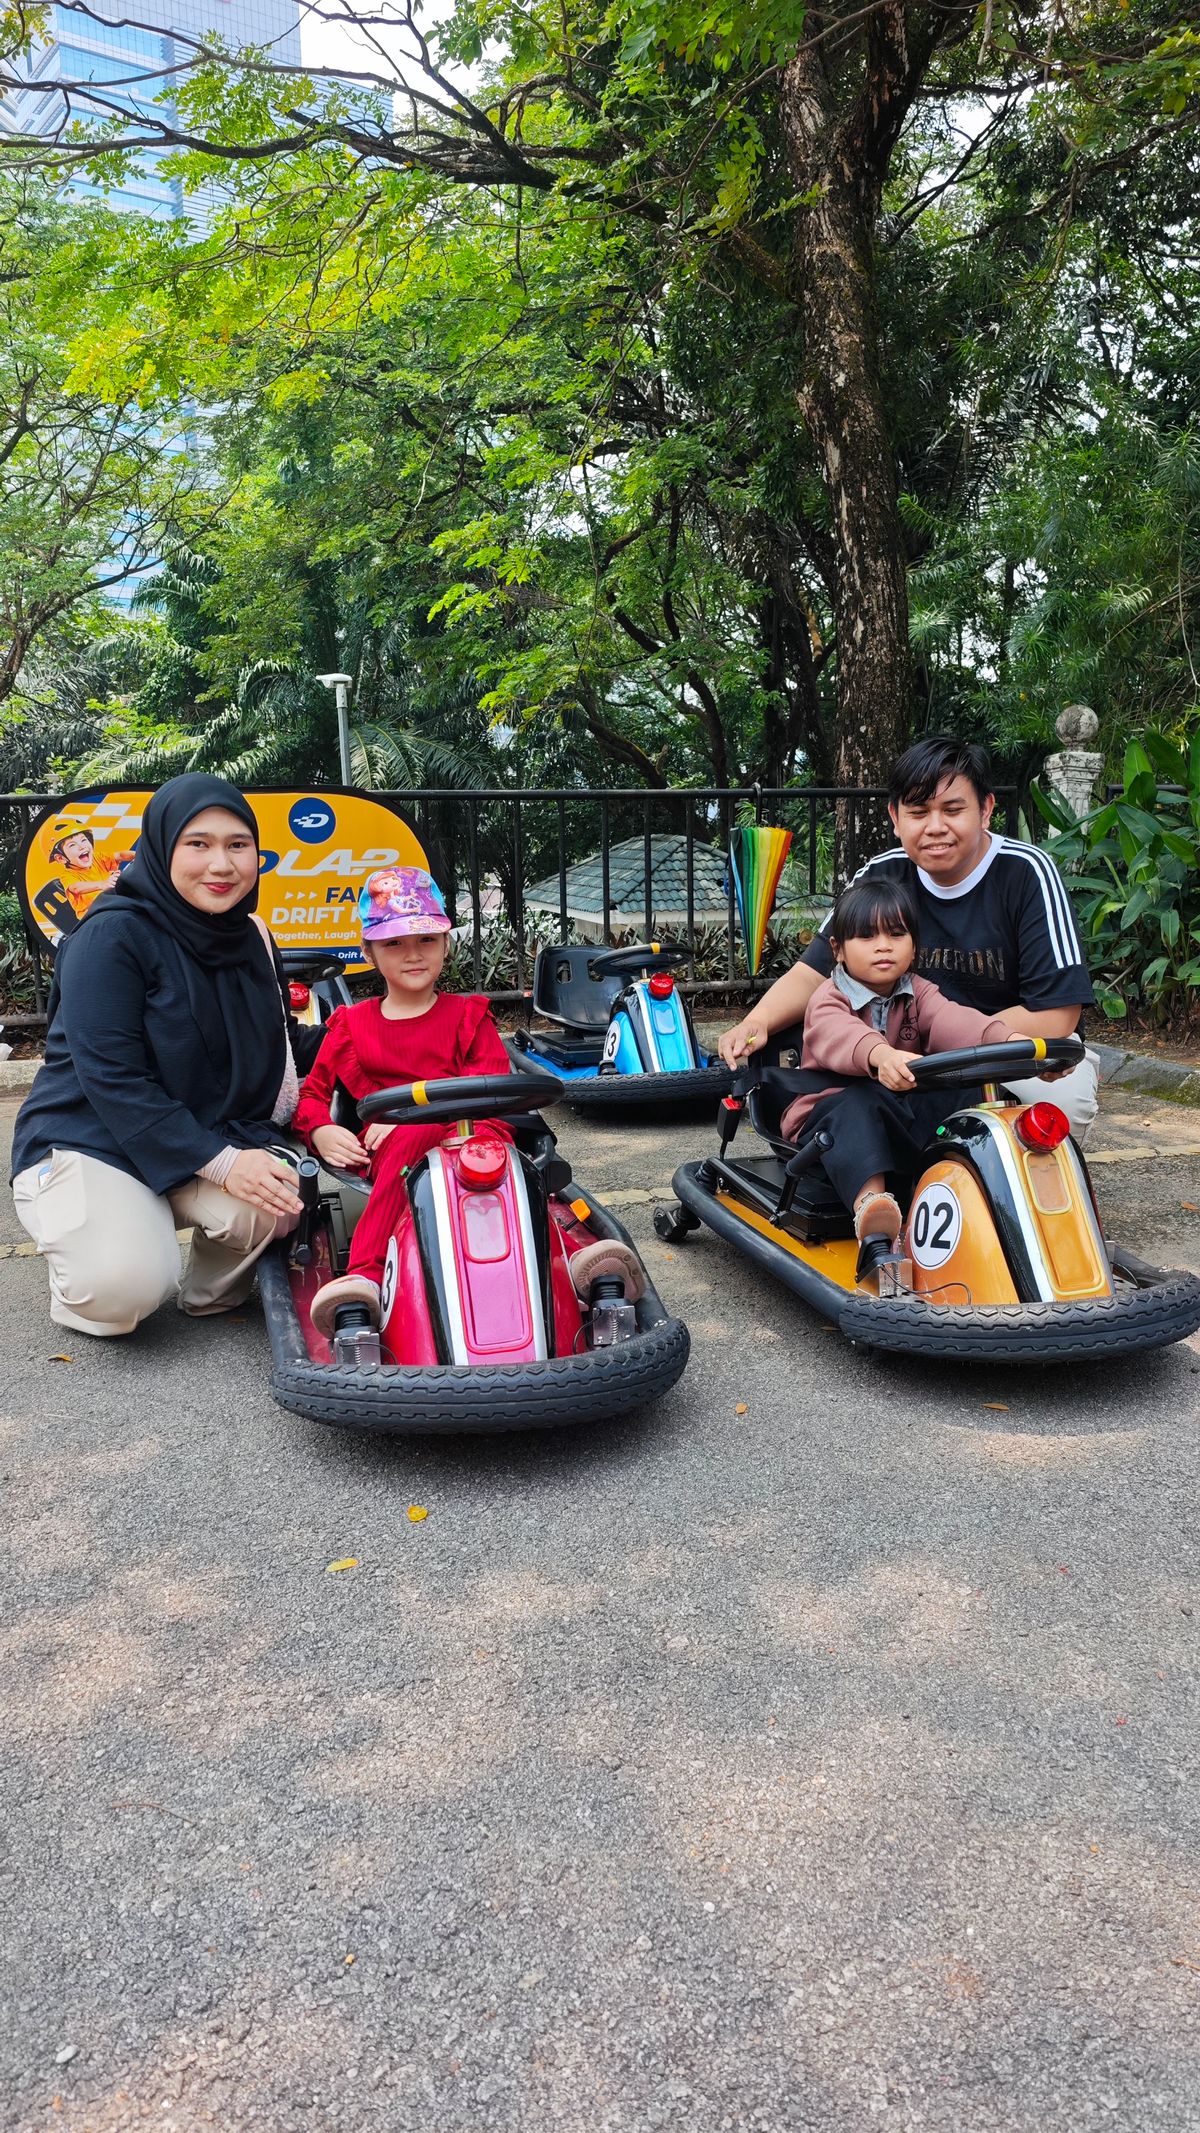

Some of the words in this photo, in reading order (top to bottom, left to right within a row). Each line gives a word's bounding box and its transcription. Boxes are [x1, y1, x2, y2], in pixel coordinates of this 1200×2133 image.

[271, 906, 345, 924] DRIFT
[324, 930, 357, 940] Laugh
[338, 951, 358, 959] Drift
[914, 1201, 954, 1250] 02
